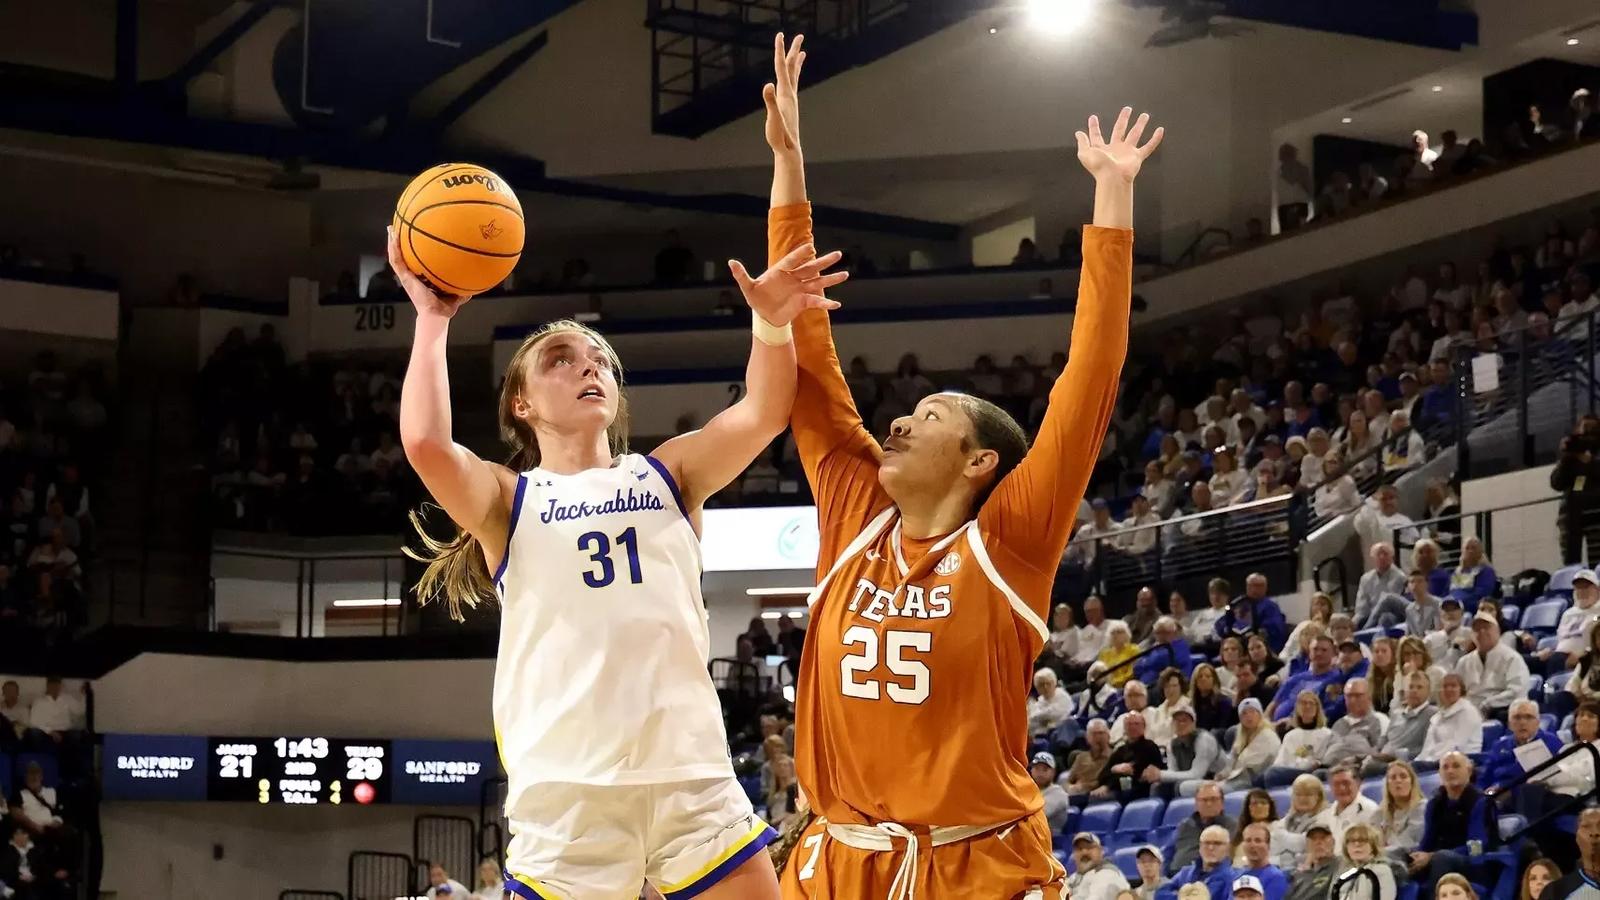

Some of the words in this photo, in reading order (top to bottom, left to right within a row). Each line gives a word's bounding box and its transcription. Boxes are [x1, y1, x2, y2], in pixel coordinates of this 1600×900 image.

[442, 174, 500, 192] lson
[354, 305, 396, 331] 209
[540, 488, 664, 524] Jackrabbits
[577, 526, 643, 588] 31
[848, 578, 952, 623] TEXAS
[840, 625, 932, 705] 25
[274, 737, 329, 758] 1:43
[117, 755, 194, 770] SANFORD
[131, 769, 179, 778] HEALTH
[219, 755, 253, 778] 21
[405, 760, 481, 775] SANFORD
[419, 774, 466, 783] HEALTH
